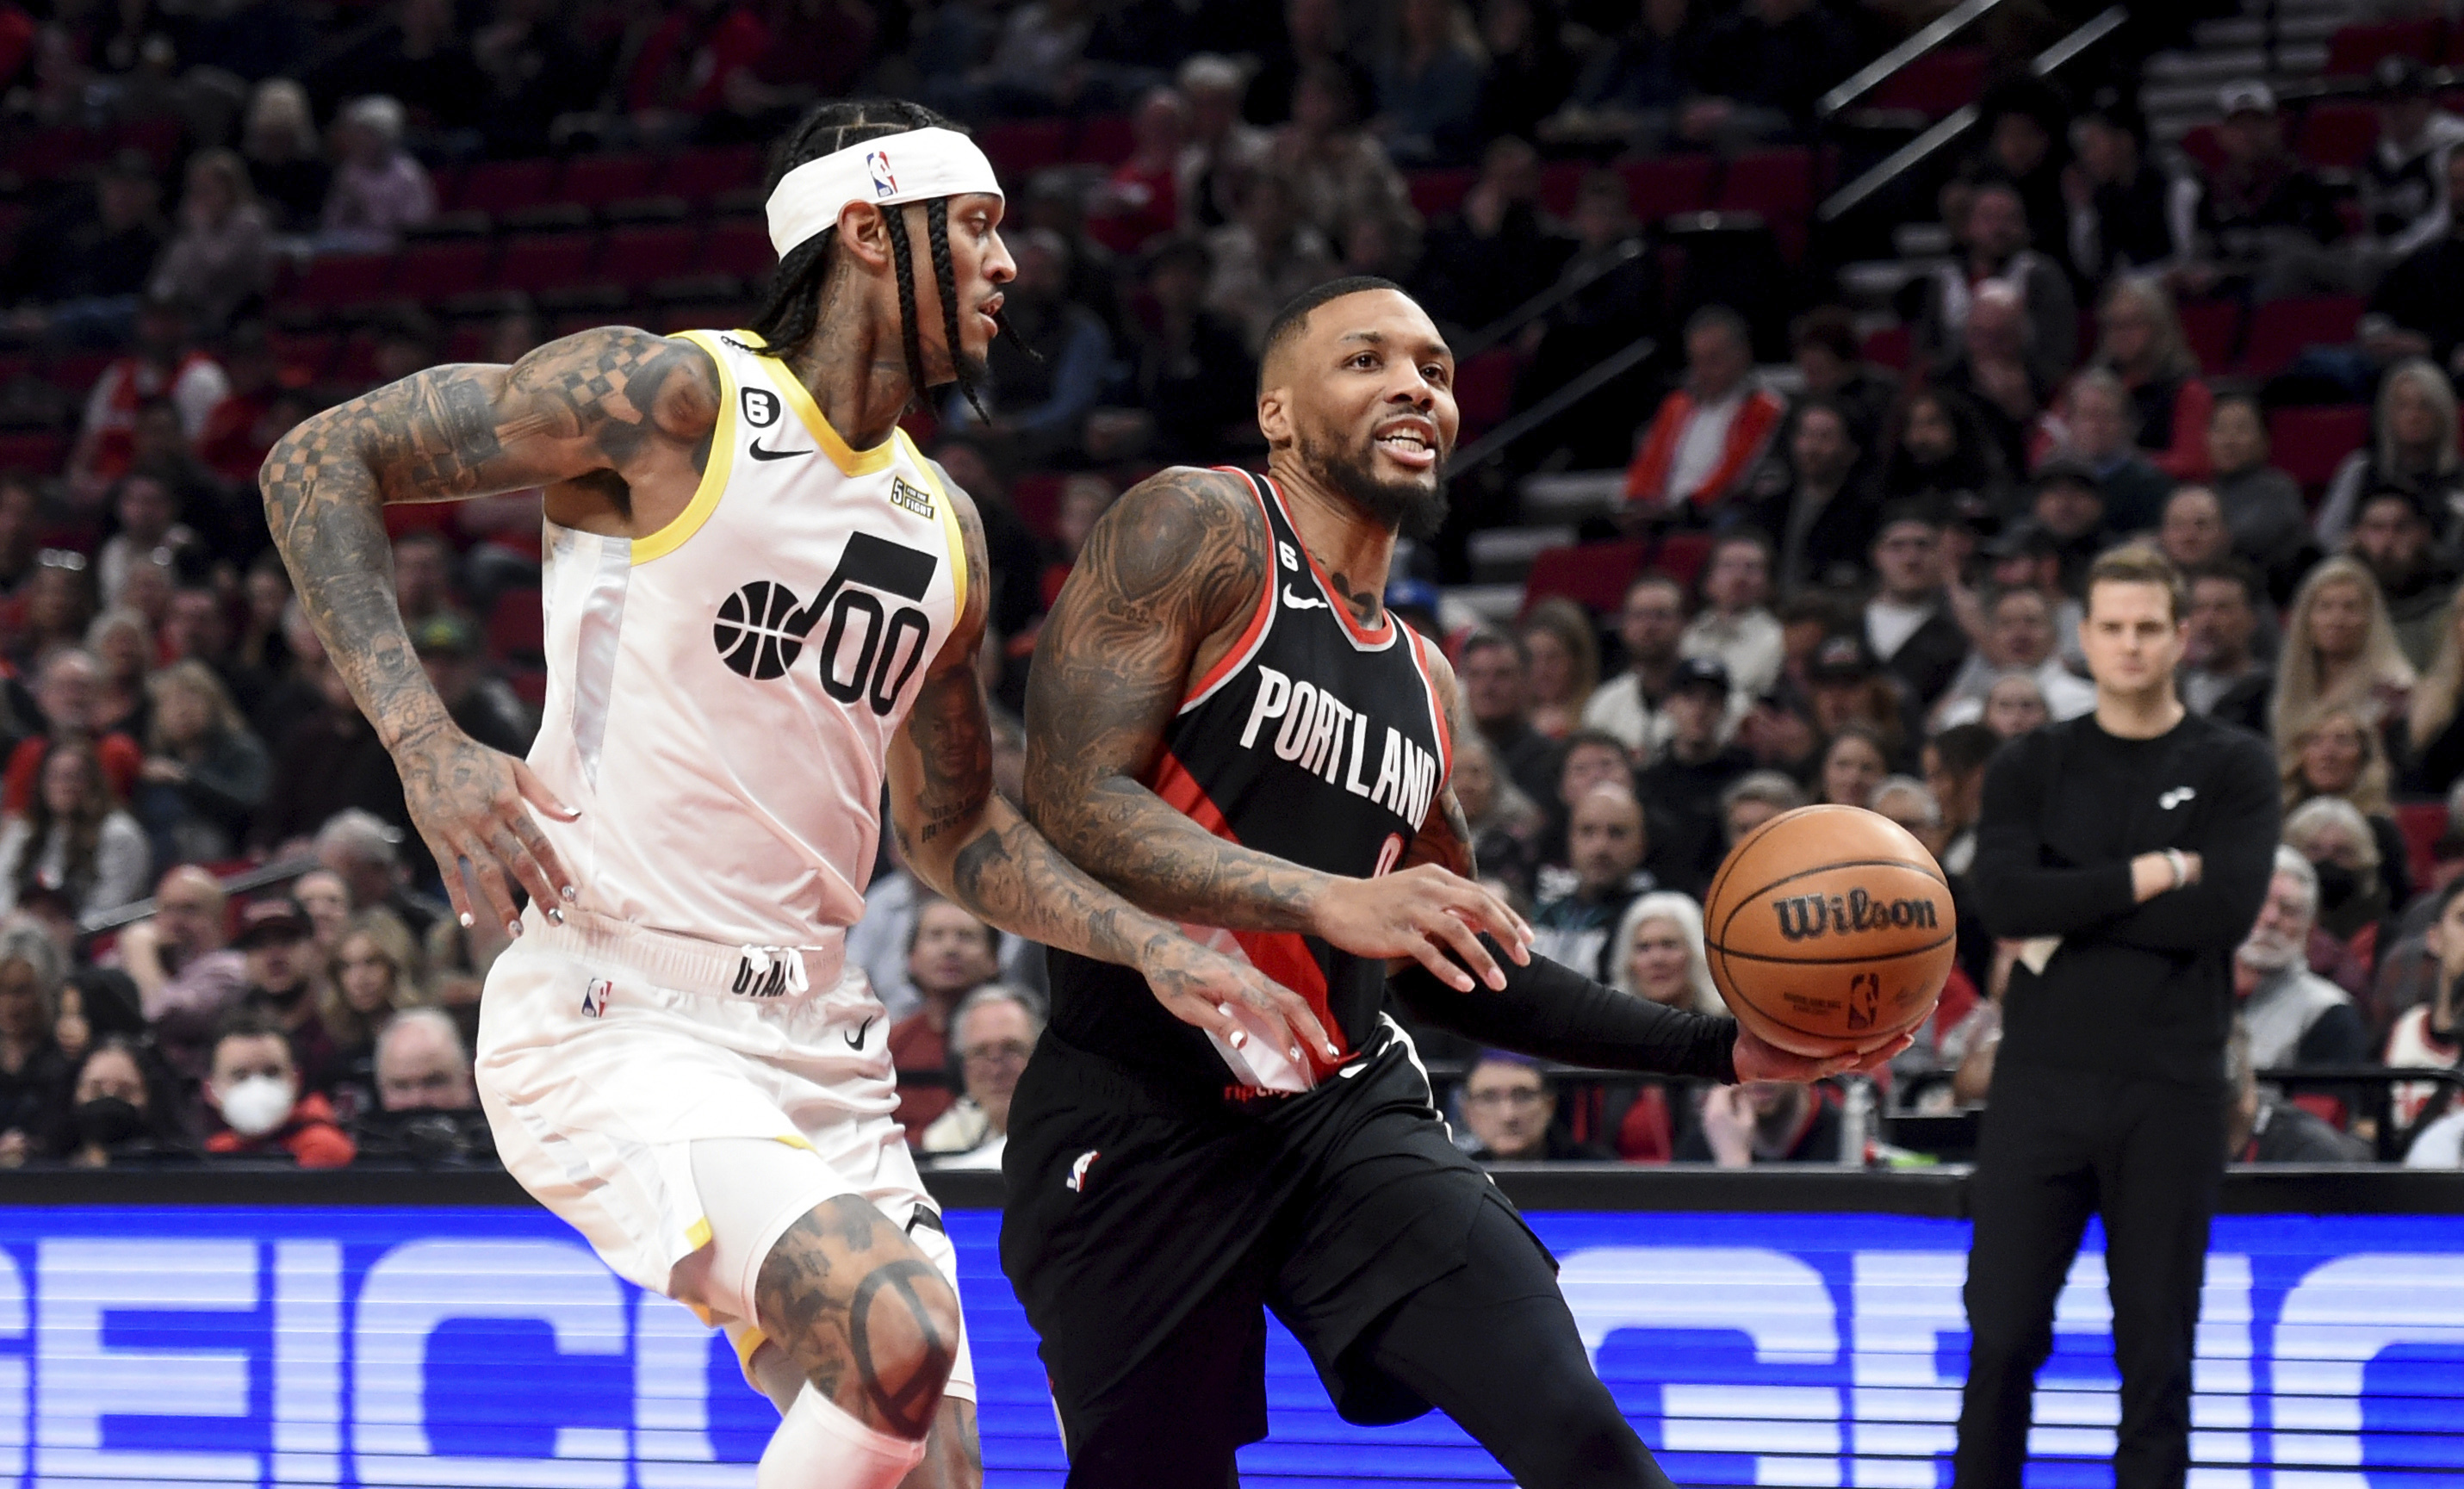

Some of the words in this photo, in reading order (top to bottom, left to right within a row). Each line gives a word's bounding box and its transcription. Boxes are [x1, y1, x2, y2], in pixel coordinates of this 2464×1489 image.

[746, 392, 770, 425] 6
[892, 480, 903, 504] 5
[906, 498, 932, 518] FIGHT
[1279, 540, 1299, 572] 6
[820, 589, 930, 717] 00
[1239, 665, 1437, 833] PORTLAND
[1772, 886, 1939, 941] Wilson
[0, 1237, 761, 1489] EIC
